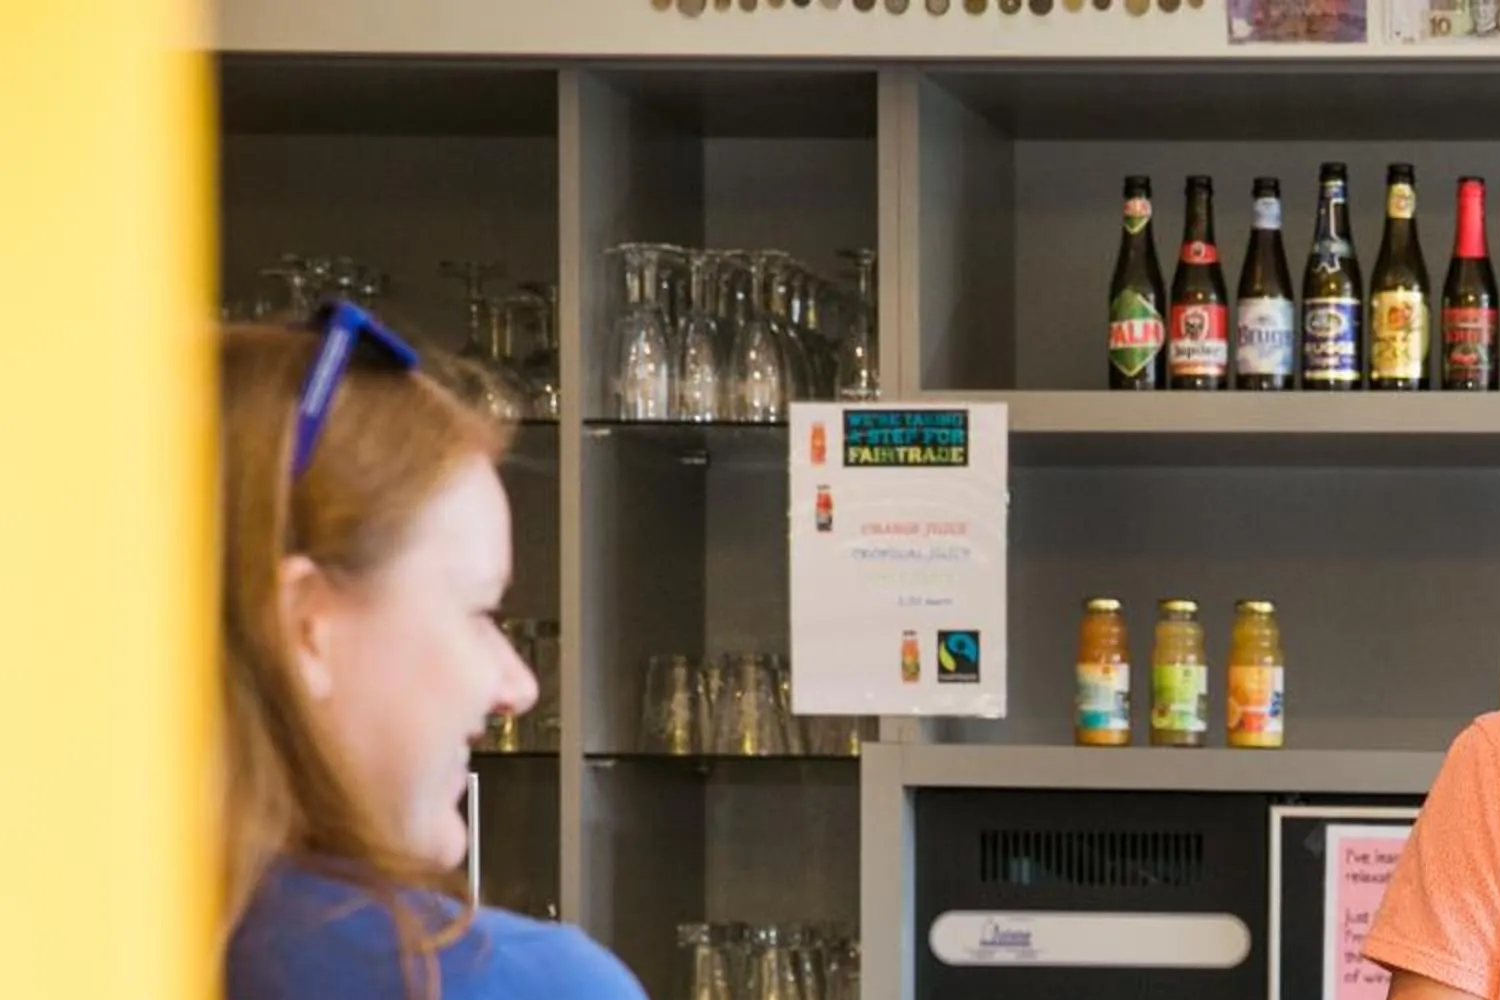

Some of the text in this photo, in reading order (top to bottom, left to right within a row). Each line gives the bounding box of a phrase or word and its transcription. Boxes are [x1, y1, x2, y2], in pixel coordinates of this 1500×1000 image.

[1430, 16, 1452, 37] 10
[867, 428, 917, 445] STEP
[922, 428, 965, 445] FOR
[848, 446, 965, 464] FAIRTRADE
[1343, 967, 1360, 984] of
